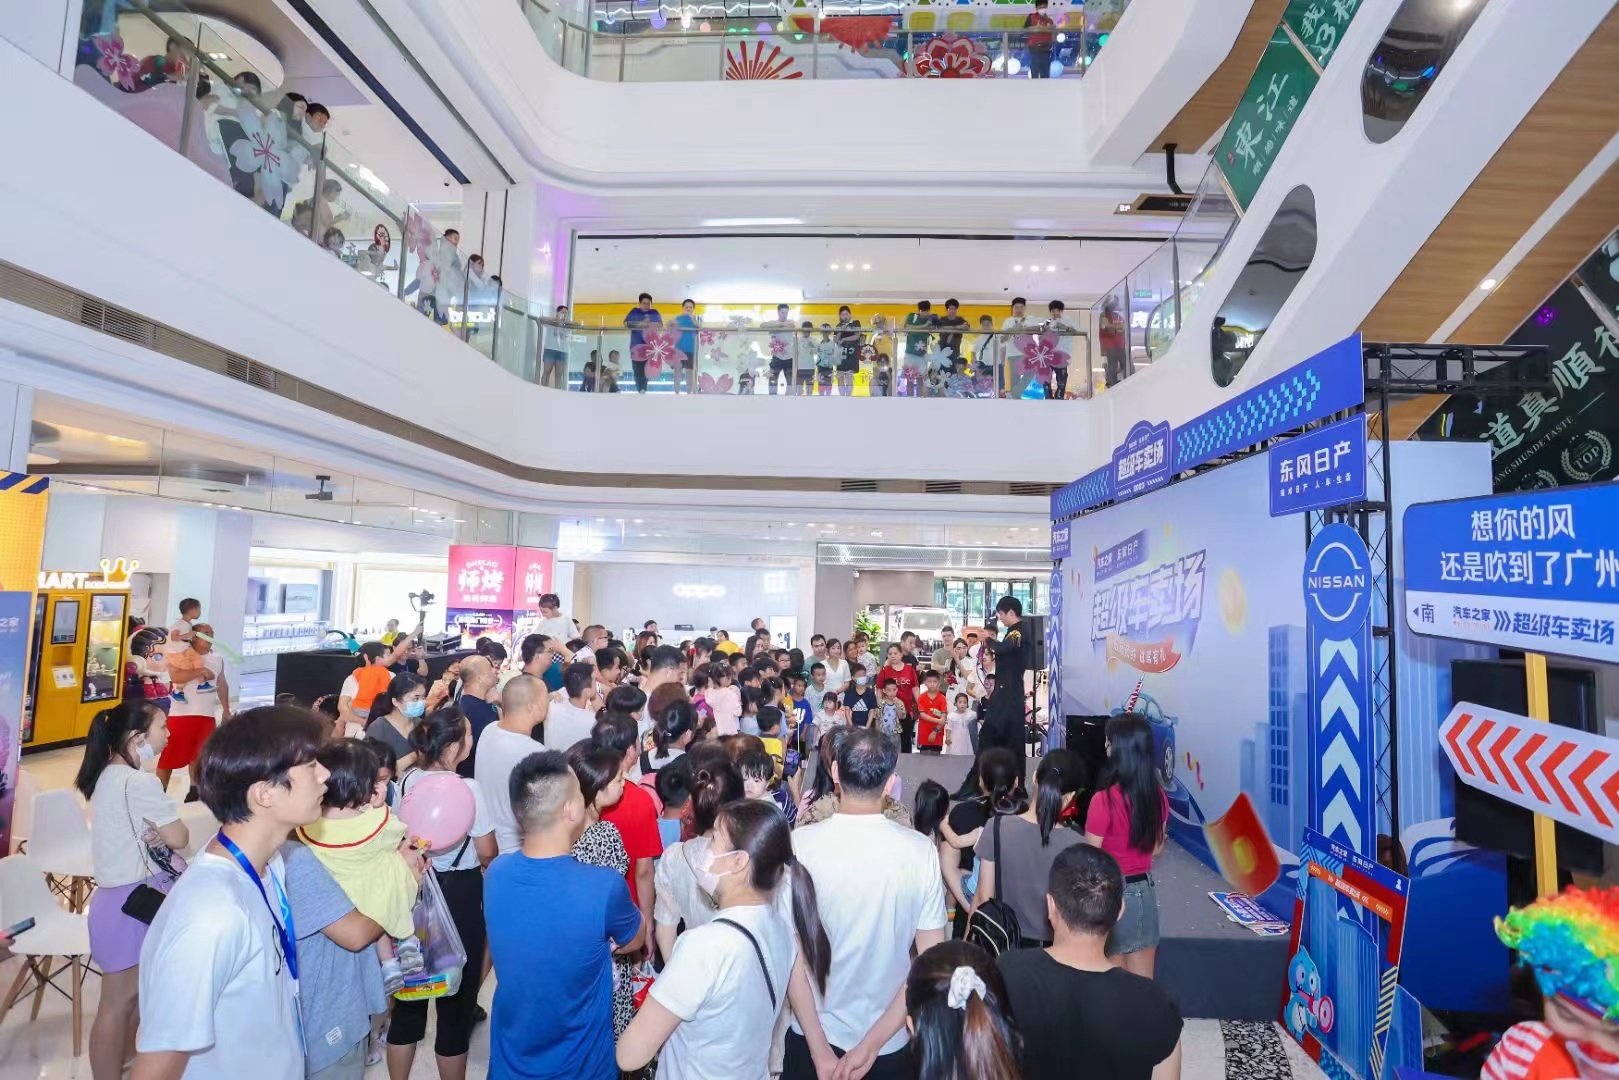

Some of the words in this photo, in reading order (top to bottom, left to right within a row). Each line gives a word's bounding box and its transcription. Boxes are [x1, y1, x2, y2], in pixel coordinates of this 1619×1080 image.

[1280, 440, 1351, 483] 东风日产
[1575, 445, 1600, 470] TOP
[1471, 504, 1576, 542] 想你的风
[1308, 574, 1365, 589] NISSAN
[1440, 548, 1619, 588] 还是吹到了广州
[1092, 550, 1205, 640] 超级车卖场
[1421, 603, 1435, 624] 南
[1452, 605, 1491, 622] 汽车之家
[1512, 611, 1615, 645] 超级车卖场
